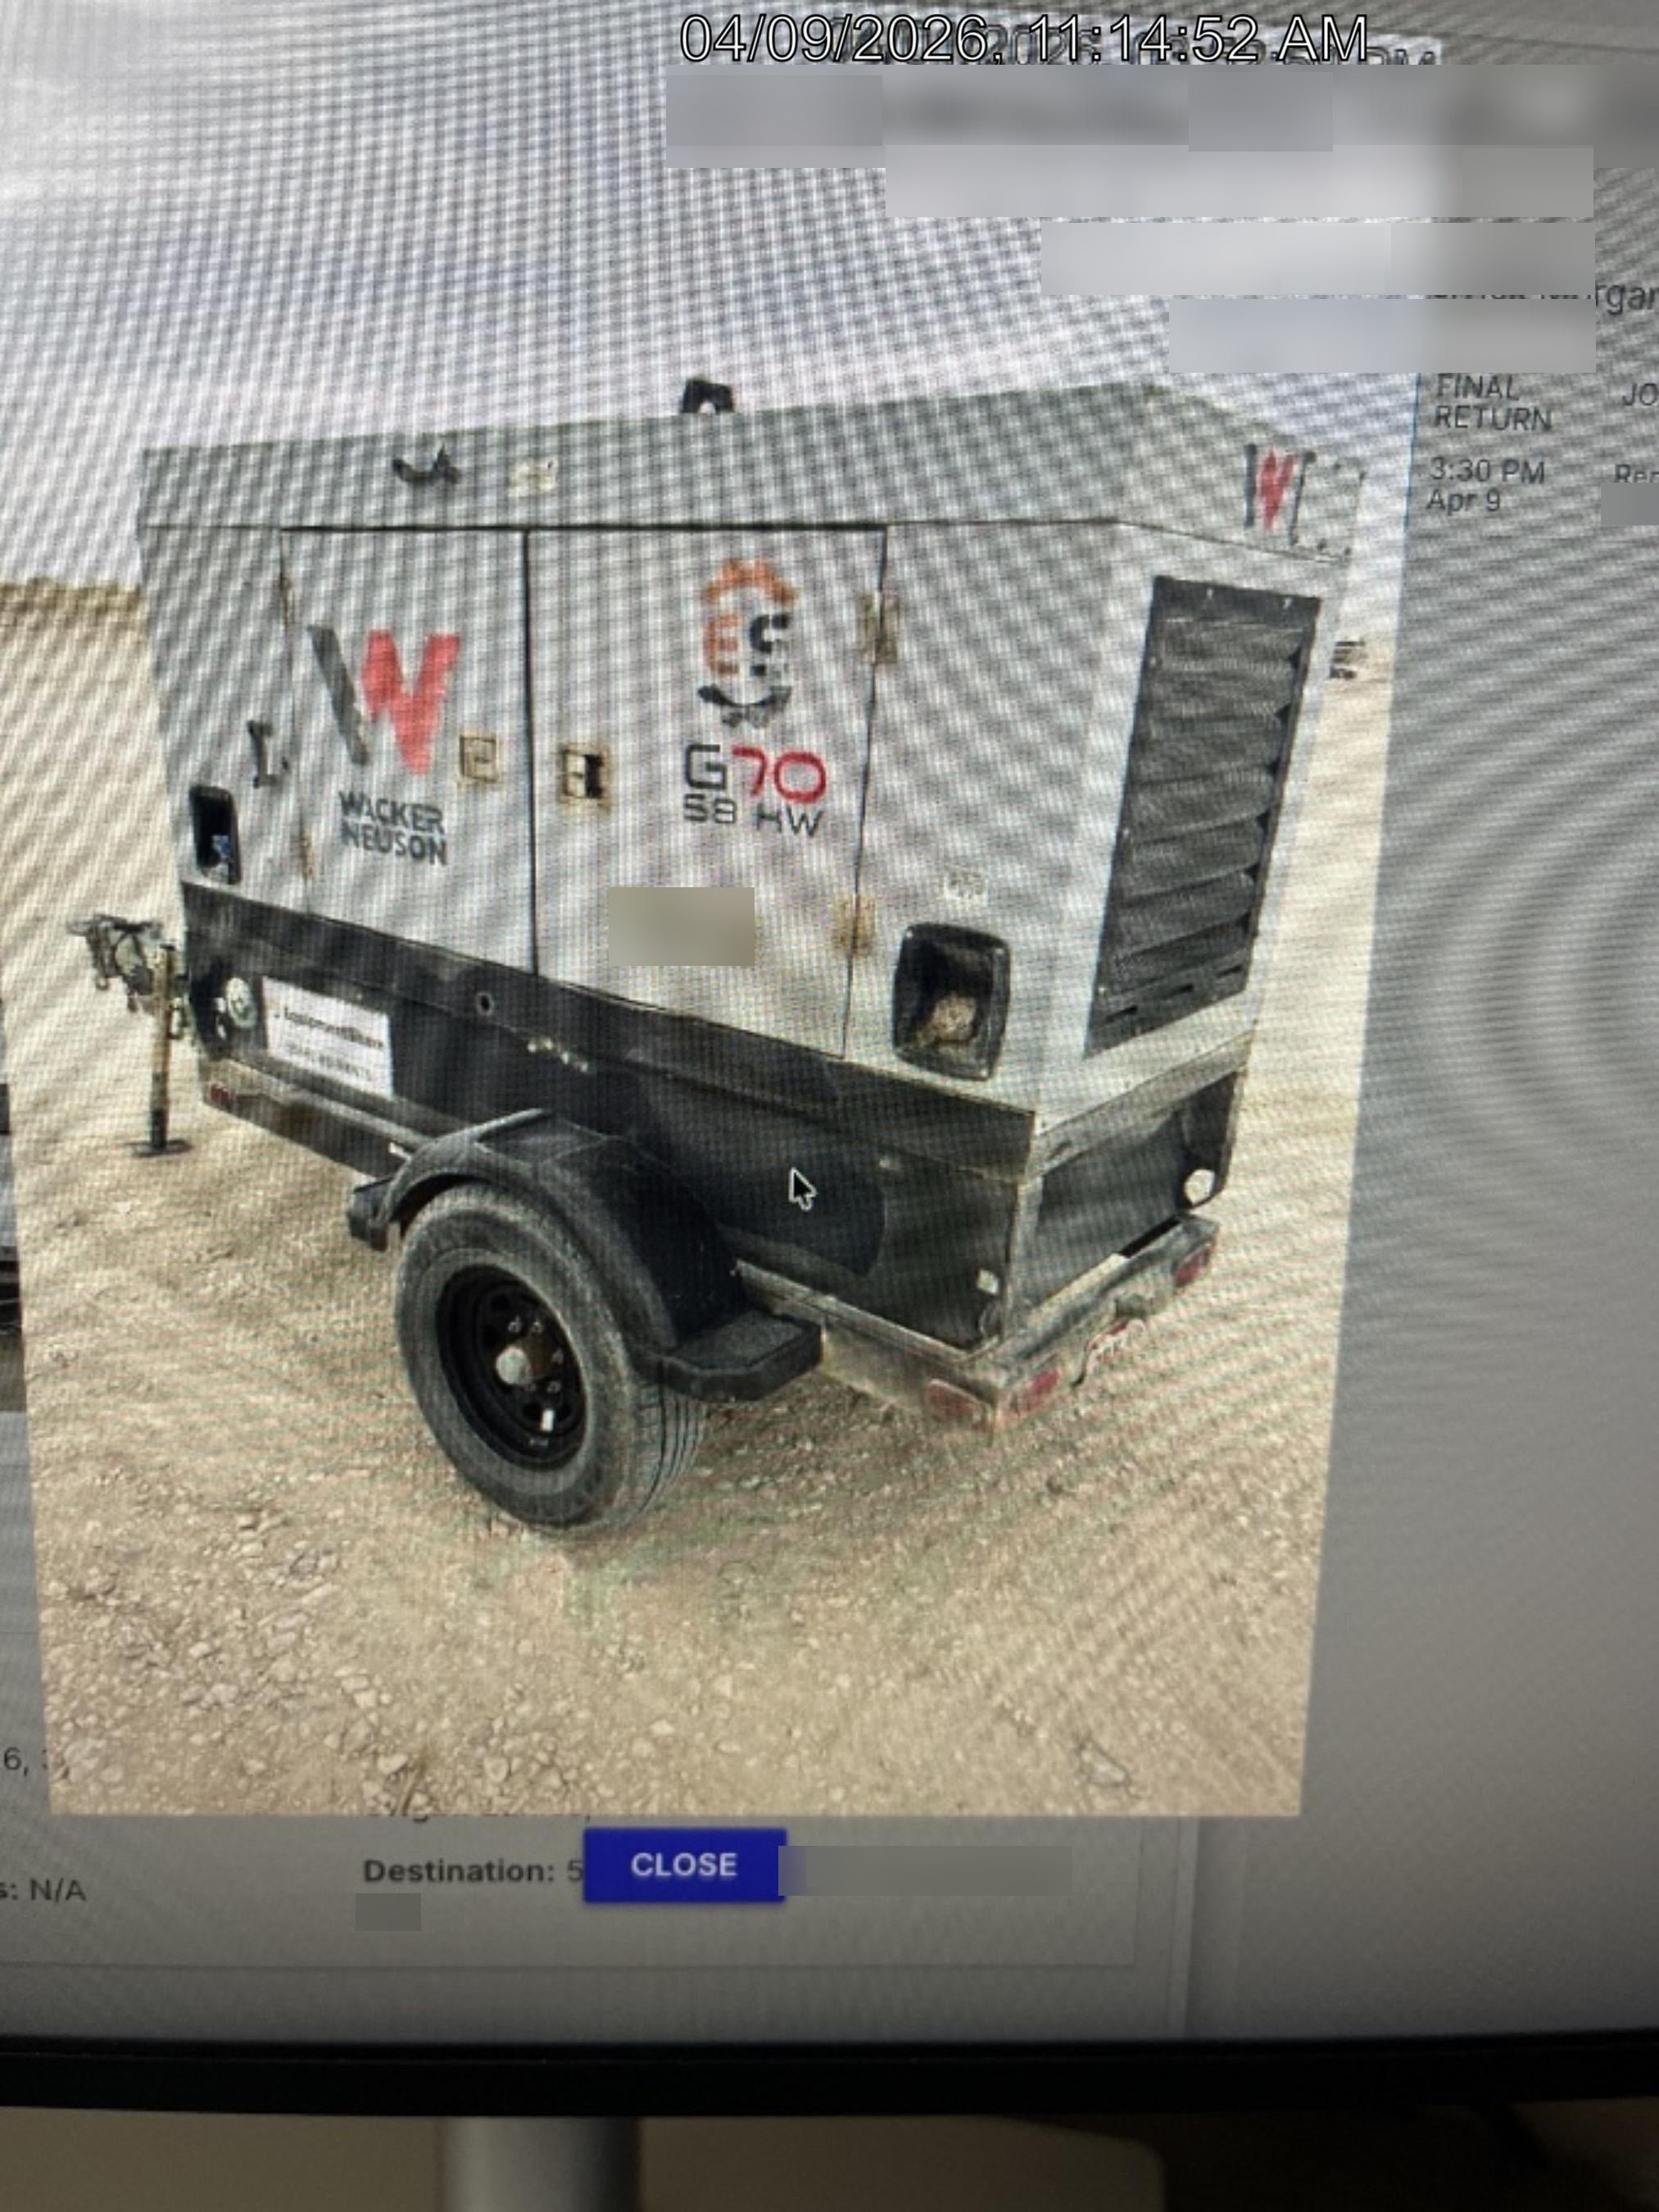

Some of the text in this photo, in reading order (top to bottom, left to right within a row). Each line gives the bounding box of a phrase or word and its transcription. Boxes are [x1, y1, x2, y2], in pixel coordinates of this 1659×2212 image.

[1437, 373, 1520, 401] FINAL
[1435, 405, 1552, 431] RETURN
[1432, 456, 1545, 484] 3:30 PM
[1426, 487, 1500, 516] Apr 9
[685, 744, 827, 803] G70
[339, 791, 445, 836] WACKER
[340, 820, 448, 866] NEUSON
[363, 1857, 555, 1883] Destination:
[631, 1852, 737, 1877] CLOSE
[29, 1878, 86, 1903] N/A
